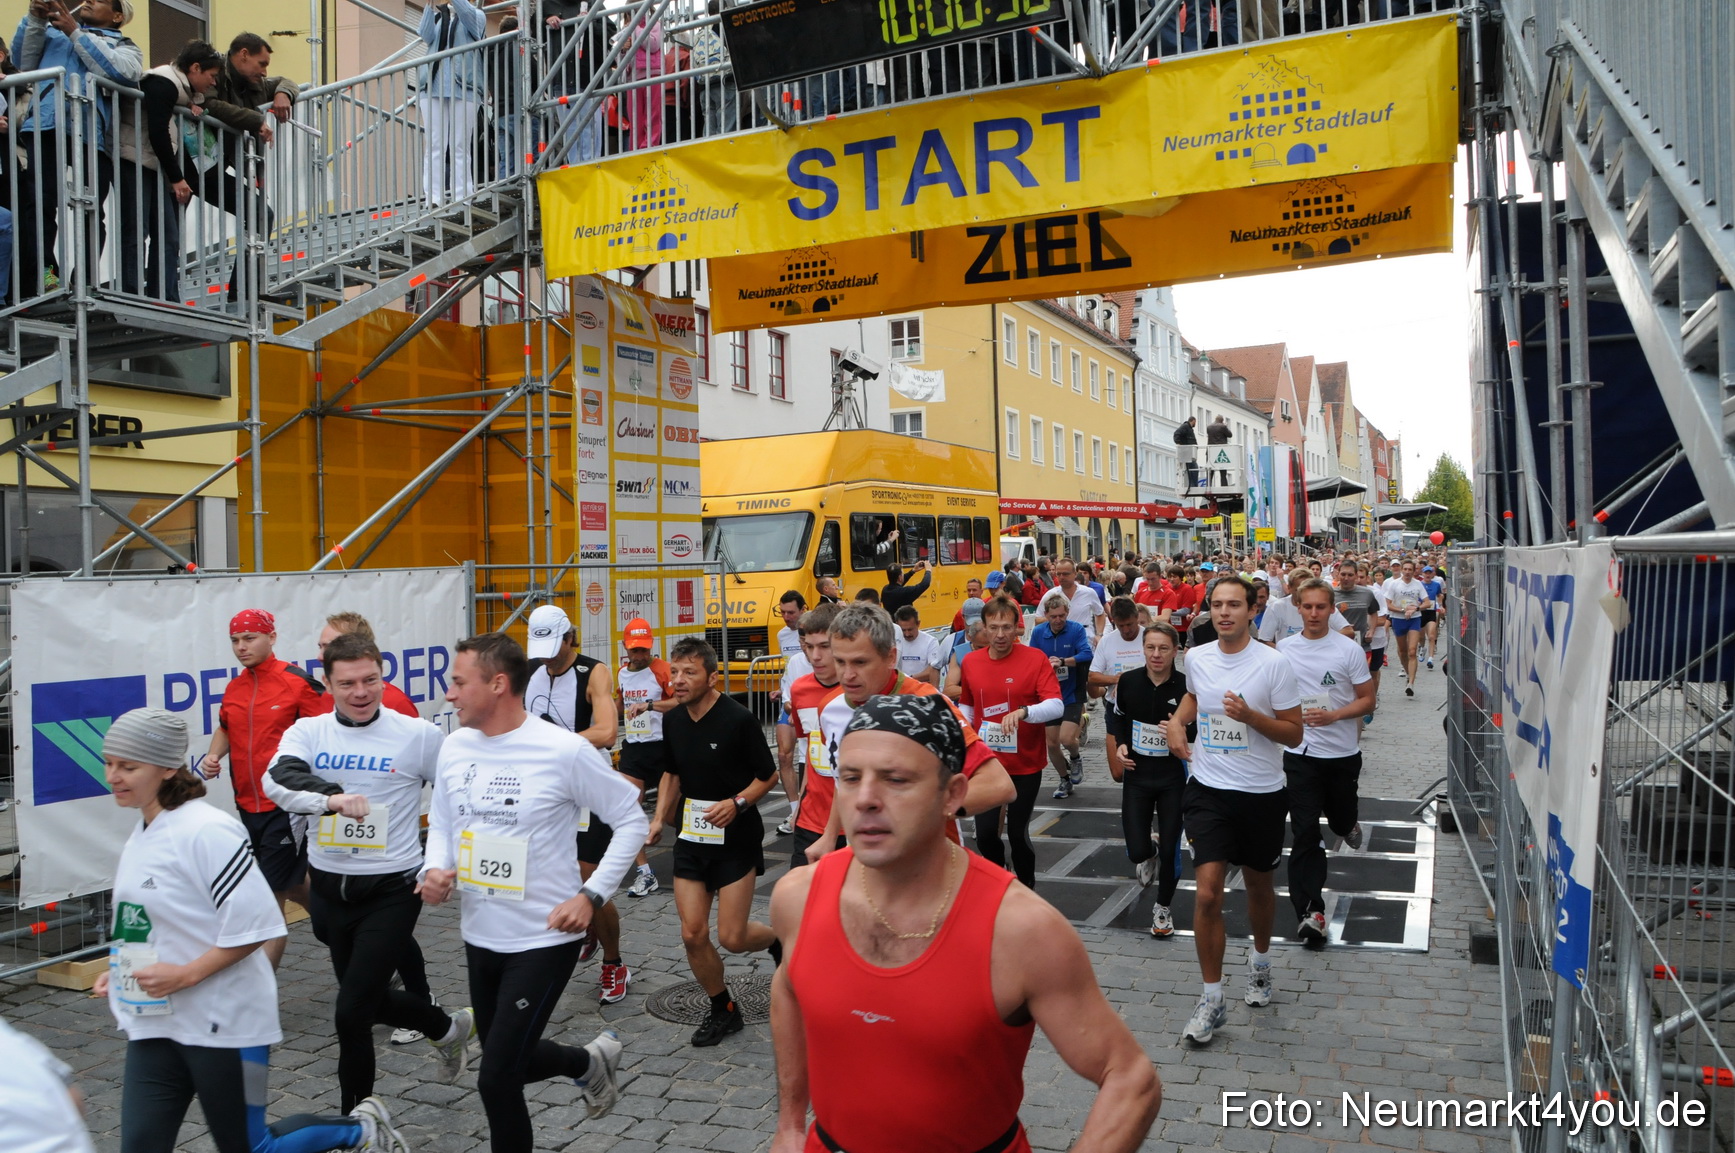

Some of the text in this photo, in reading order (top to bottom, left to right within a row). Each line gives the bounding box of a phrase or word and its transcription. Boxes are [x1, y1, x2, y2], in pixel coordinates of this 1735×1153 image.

[732, 2, 796, 27] SPORTRONIC
[1163, 103, 1395, 153] Neumarkter Stadtlauf
[786, 106, 1101, 221] START
[574, 203, 738, 240] Neumarkter Stadtlauf
[1230, 206, 1412, 243] Neumarkter Stadtlauf
[965, 211, 1132, 285] ZIEL
[738, 273, 880, 301] Neumarkter Stadtlauf
[654, 313, 696, 332] MERZ
[583, 365, 599, 374] KANN
[578, 432, 606, 447] Sinupret
[664, 425, 699, 443] OBI
[578, 448, 595, 459] forte
[616, 480, 642, 493] swn
[664, 480, 689, 494] MCM
[872, 490, 901, 500] SPORTRONIC
[947, 496, 976, 507] EVENT SERVICE
[736, 498, 791, 511] TIMING
[1076, 504, 1105, 512] Serviceline:
[580, 551, 608, 559] HACKNER
[642, 546, 656, 554] BÖGL
[620, 590, 654, 605] Sinupret
[620, 608, 640, 620] forte
[625, 689, 648, 698] MERZ
[632, 720, 646, 729] 426
[1211, 717, 1223, 725] Max
[988, 735, 1011, 743] 2331
[1142, 735, 1167, 746] 2436
[1213, 730, 1242, 741] 2744
[315, 752, 396, 773] QUELLE.
[471, 808, 518, 818] Neumarkter
[482, 816, 518, 826] Stadtlauf
[344, 823, 376, 839] 653
[479, 859, 512, 878] 529
